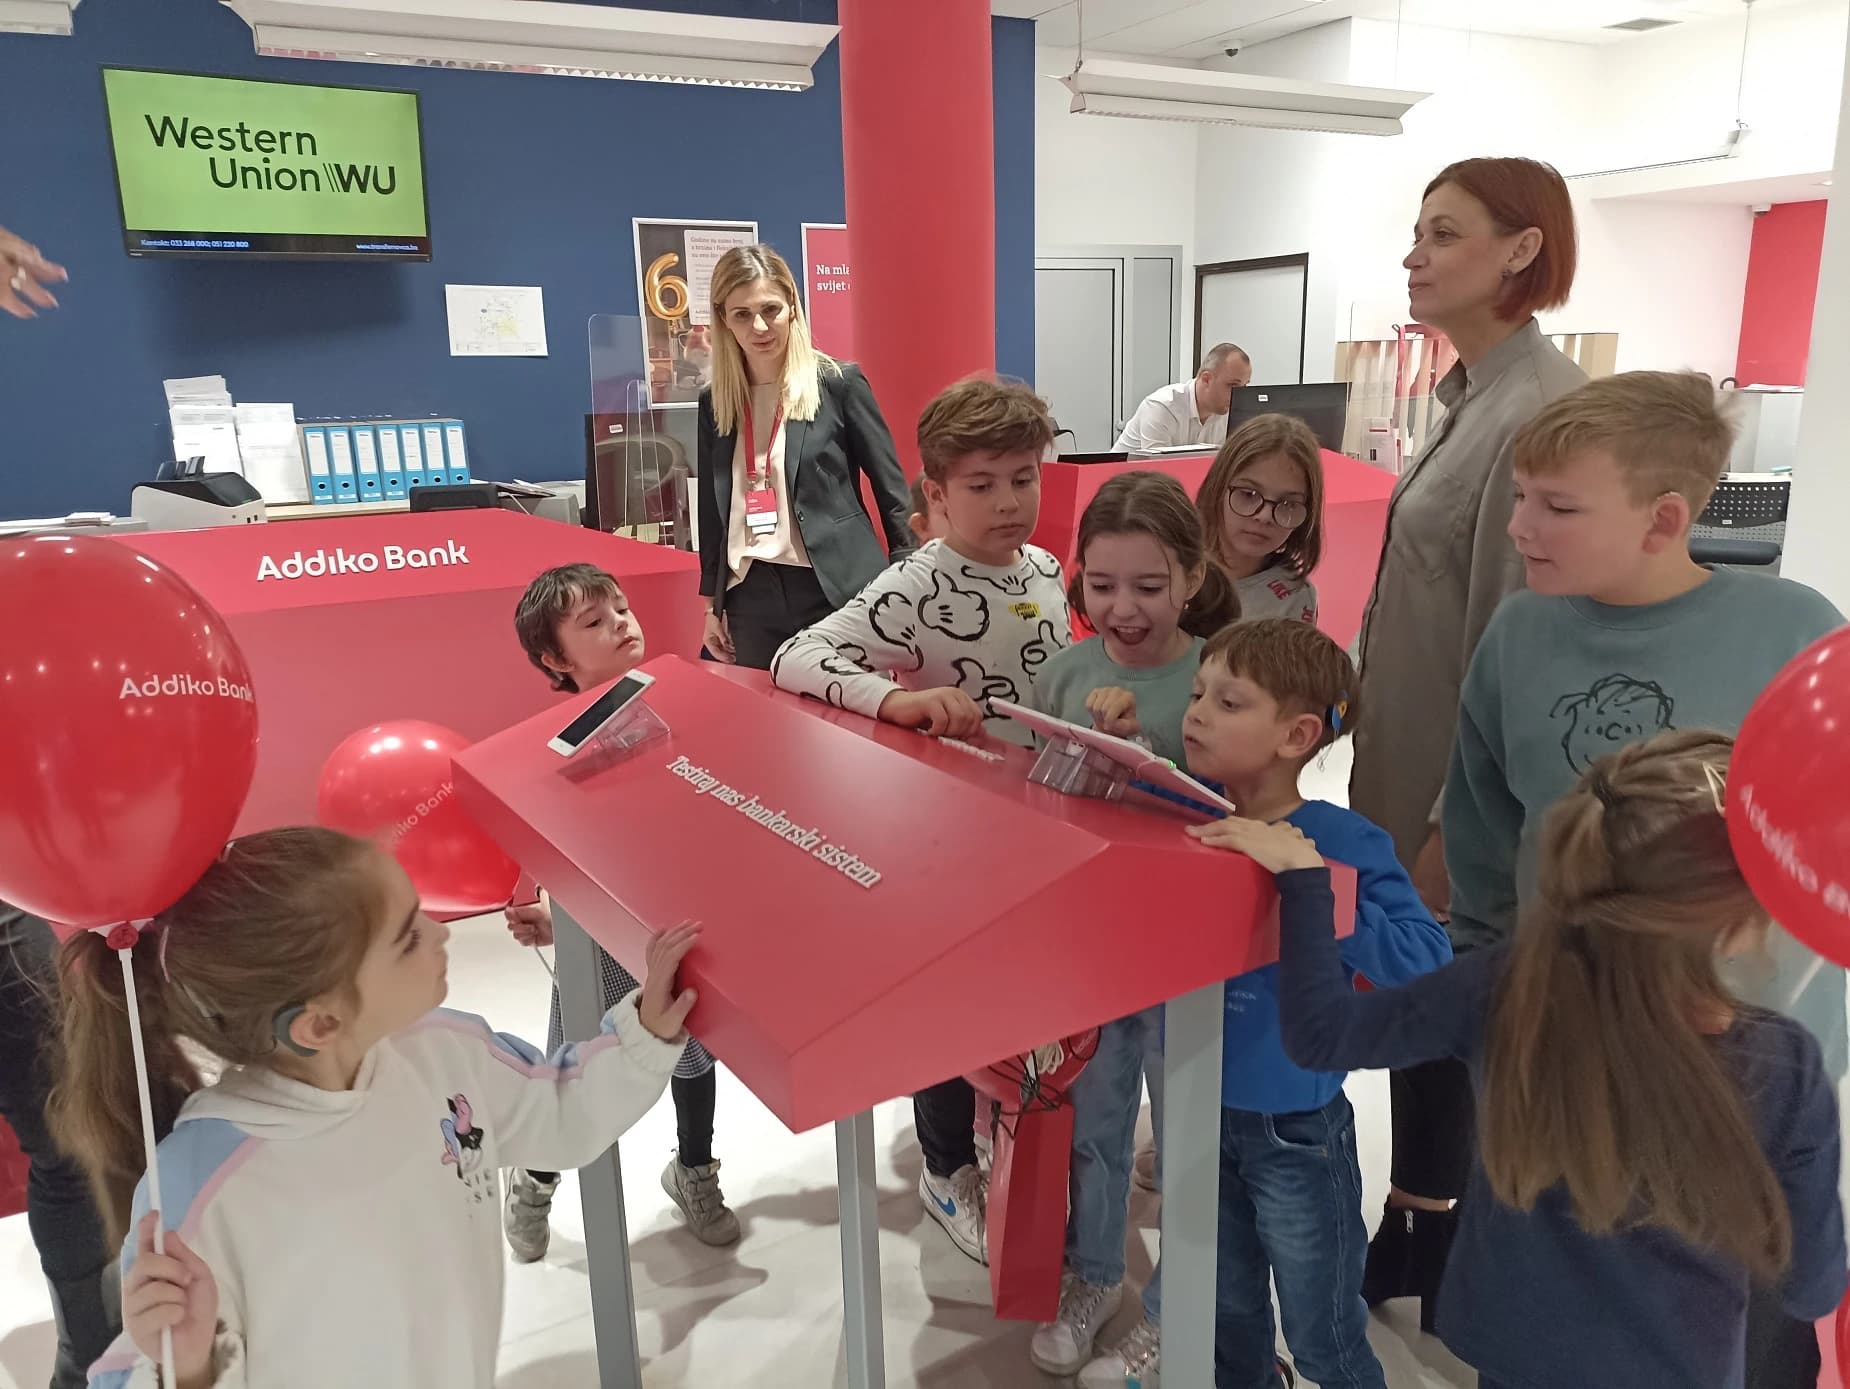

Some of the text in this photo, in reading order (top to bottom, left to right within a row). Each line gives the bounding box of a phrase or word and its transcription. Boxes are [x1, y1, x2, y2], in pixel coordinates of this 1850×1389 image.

[144, 114, 317, 156] Western
[209, 157, 320, 192] Union
[816, 264, 850, 275] Na mla
[816, 280, 846, 293] svijet
[257, 539, 470, 582] Addiko Bank
[119, 674, 214, 699] Addiko
[416, 782, 454, 816] Bank
[735, 795, 828, 852] bankarski
[812, 844, 882, 889] sistem
